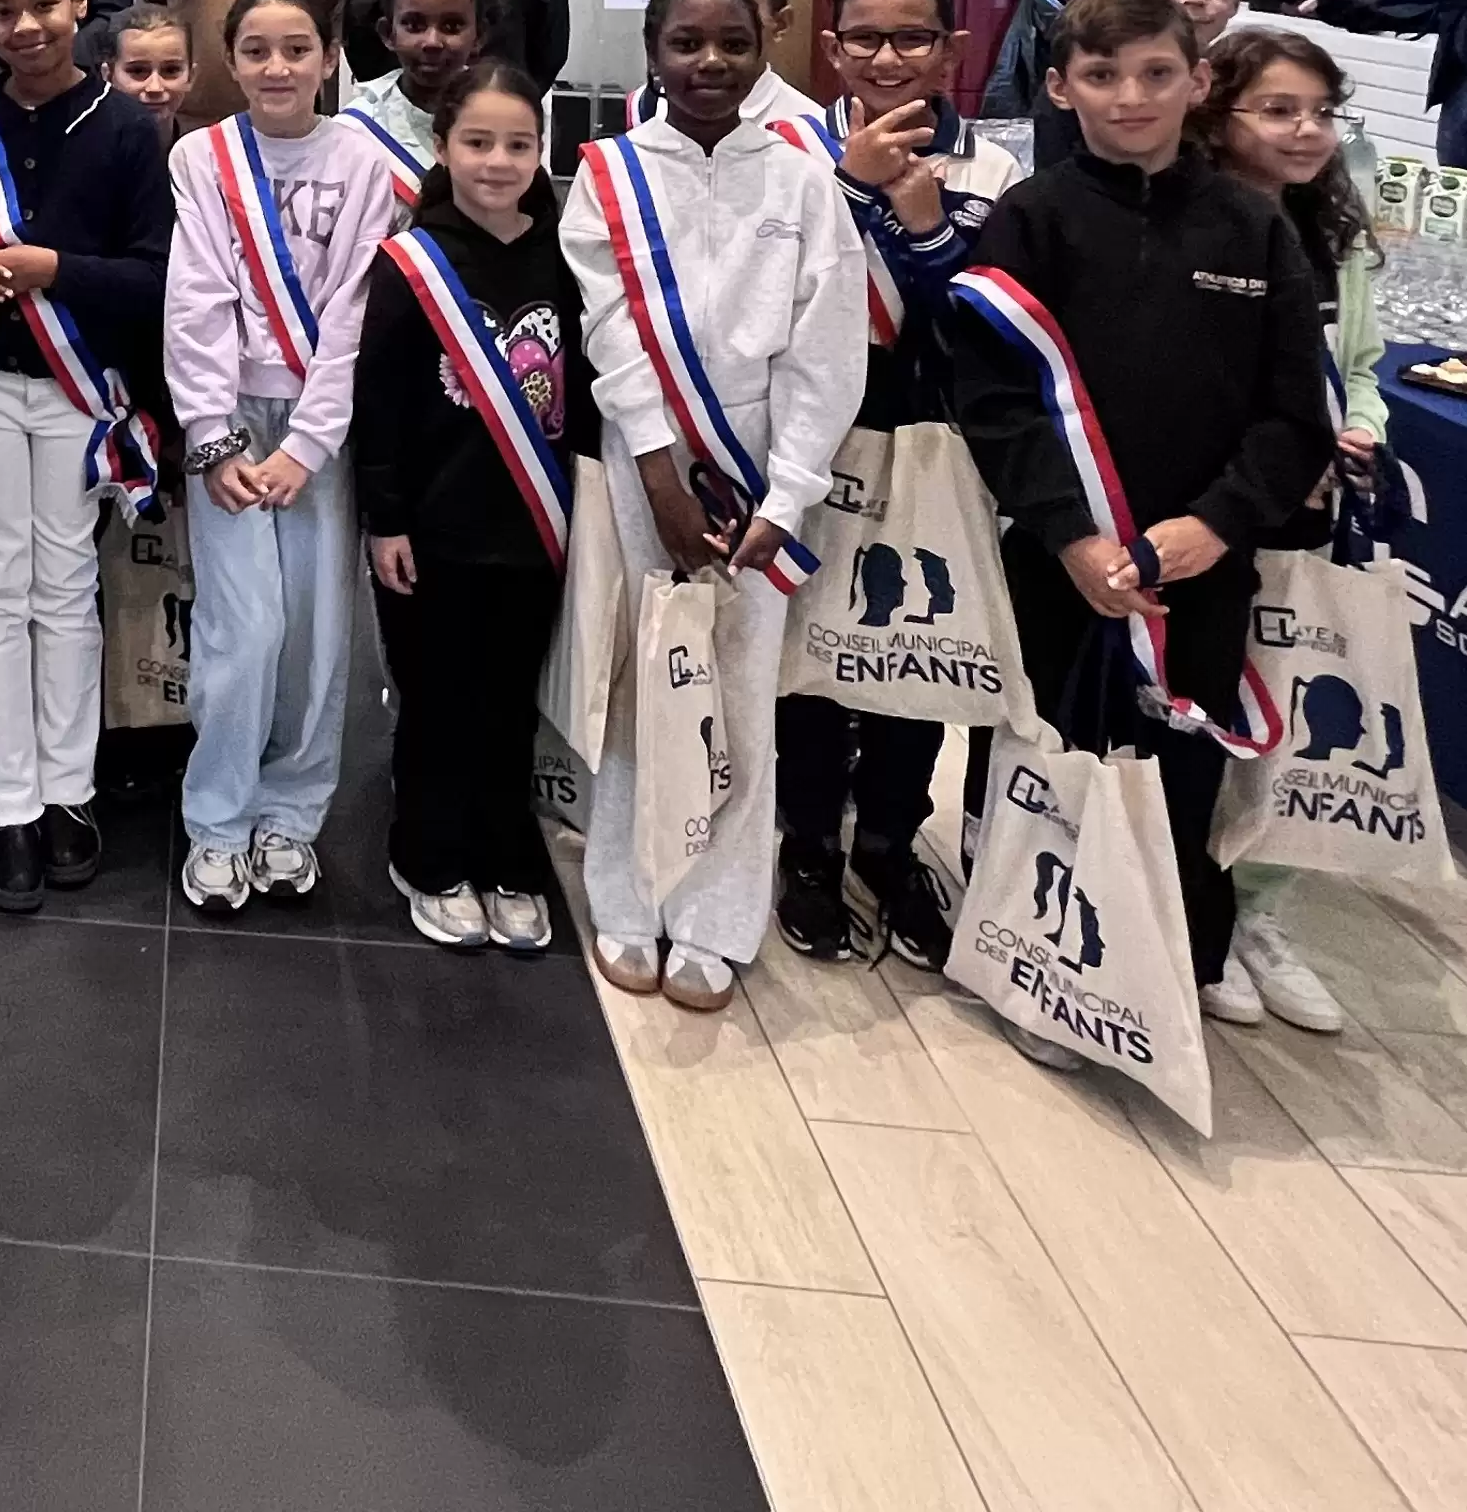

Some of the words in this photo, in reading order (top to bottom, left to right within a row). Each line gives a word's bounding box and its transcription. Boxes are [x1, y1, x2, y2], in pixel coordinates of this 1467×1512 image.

[887, 632, 999, 662] MUNICIPAL
[836, 652, 1003, 695] ENFANTS
[1010, 955, 1154, 1065] ENFANTS
